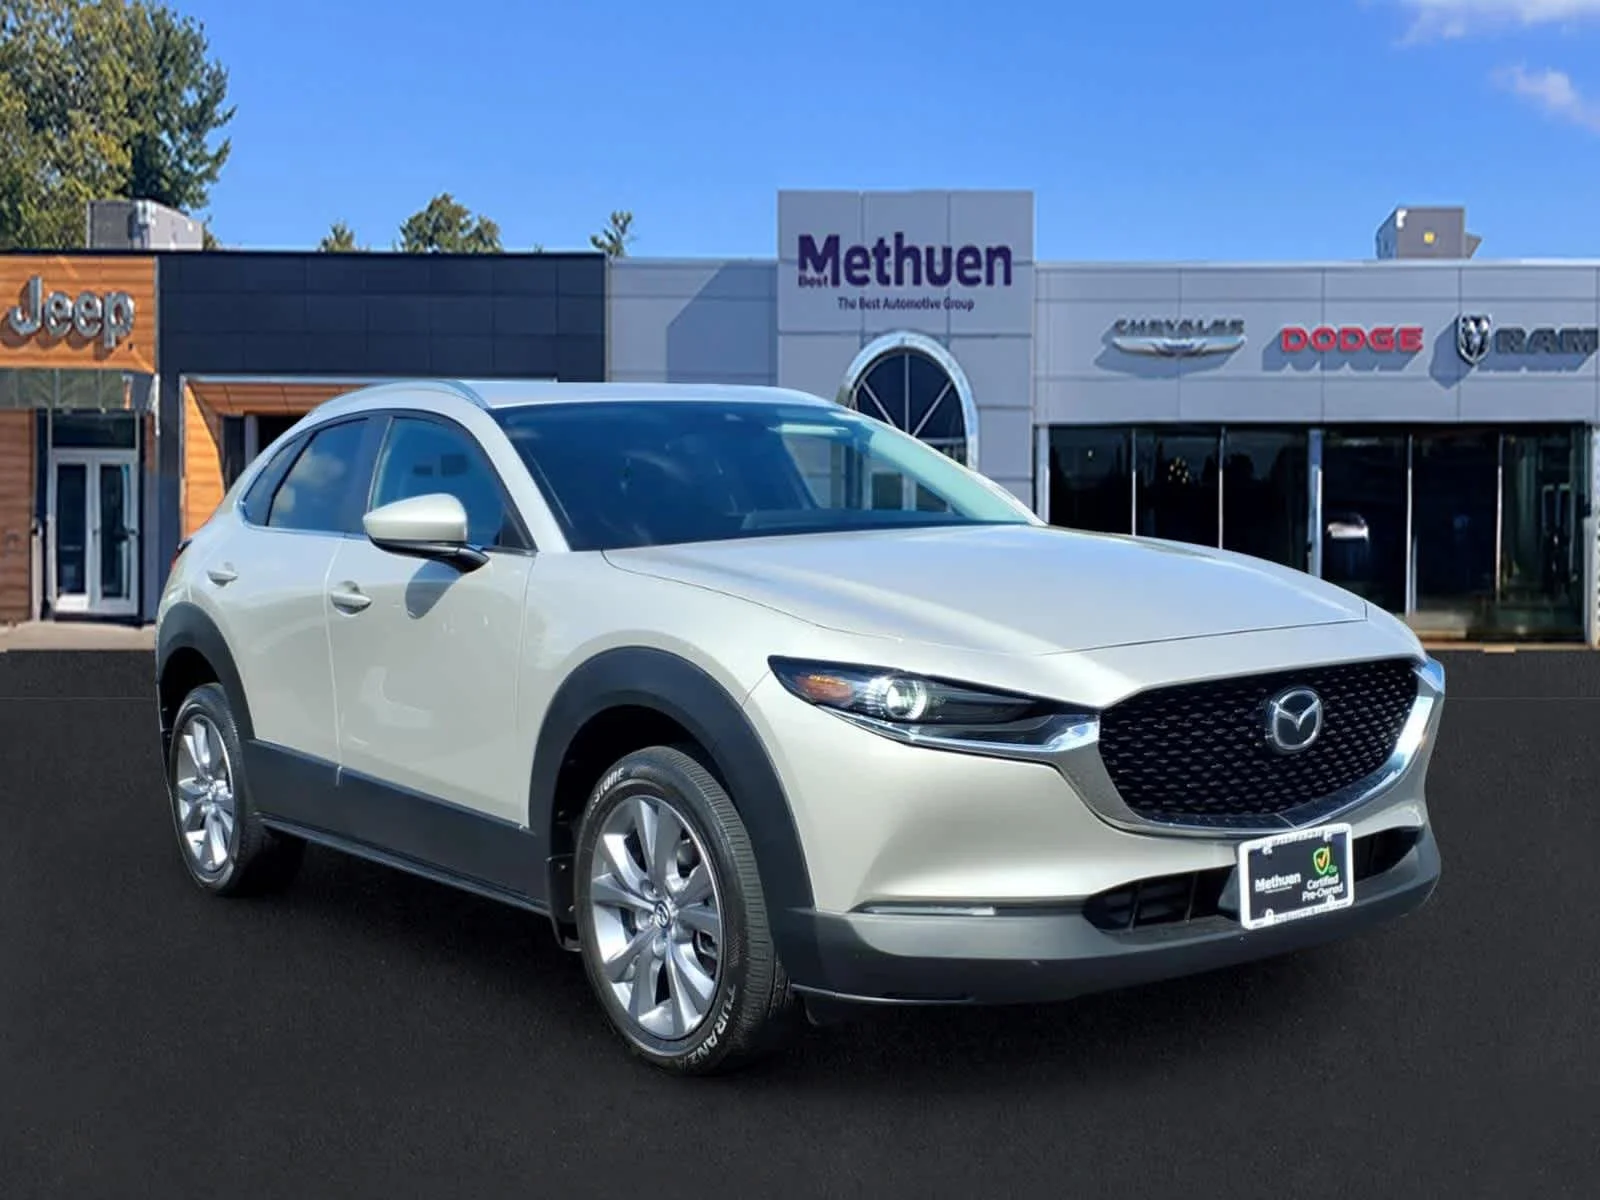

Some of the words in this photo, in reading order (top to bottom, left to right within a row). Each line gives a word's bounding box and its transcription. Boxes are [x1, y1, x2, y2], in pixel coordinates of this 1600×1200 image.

[798, 232, 1012, 287] Methuen
[9, 275, 135, 348] Jeep
[838, 297, 856, 309] The
[859, 297, 880, 309] Best
[883, 297, 941, 310] Automotive
[944, 297, 974, 311] Group
[1281, 327, 1424, 352] DODGE
[1494, 328, 1599, 353] RAM
[1255, 872, 1301, 891] Methuen
[1302, 882, 1343, 901] Pre-Owned
[1307, 873, 1339, 890] Certified
